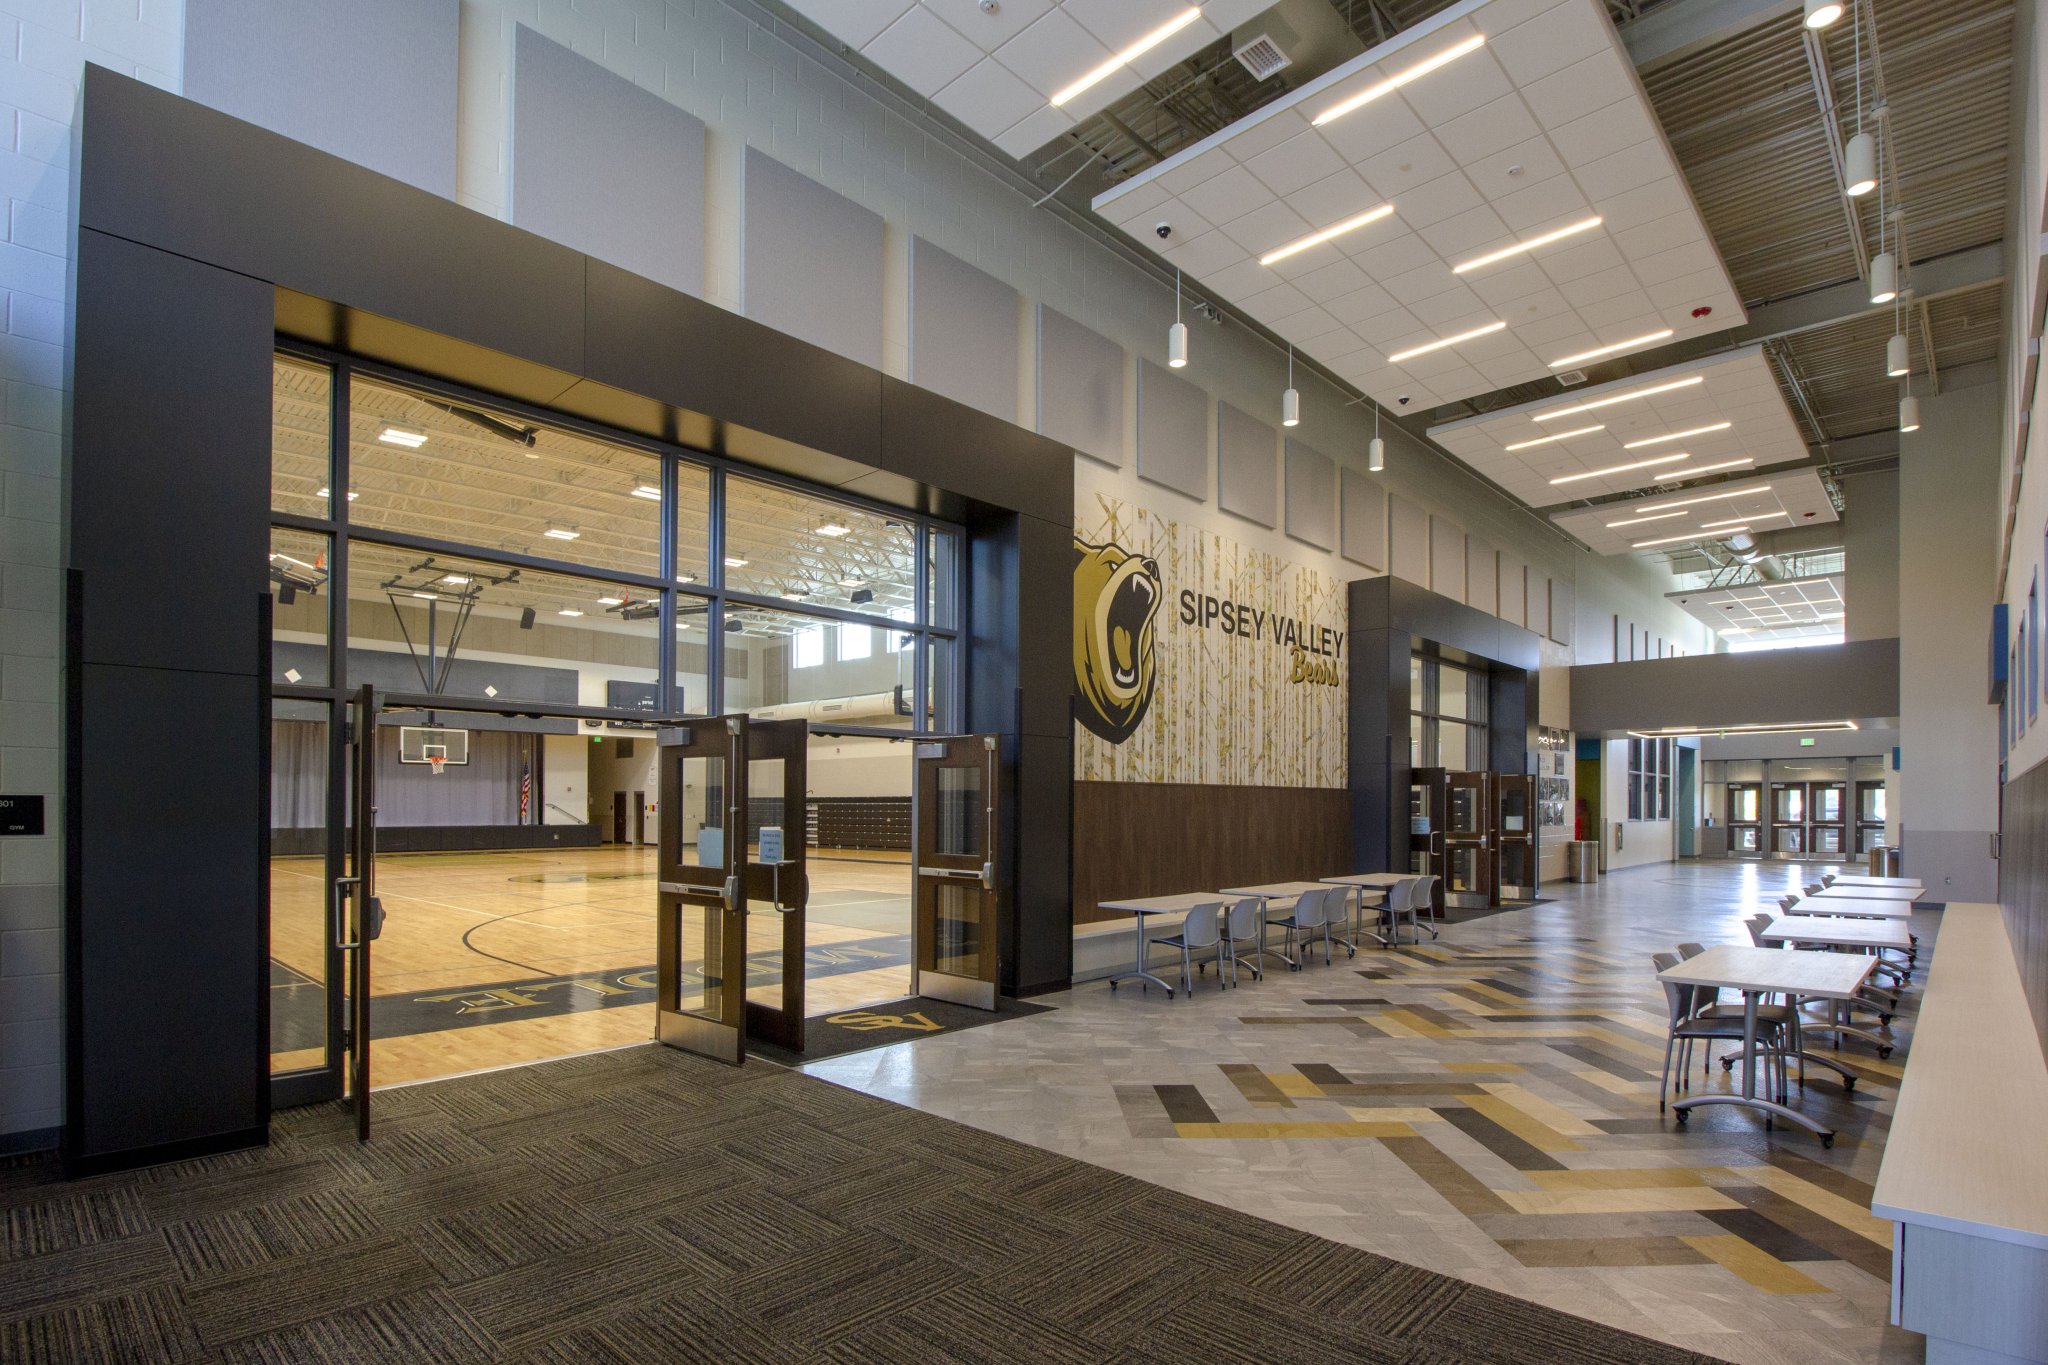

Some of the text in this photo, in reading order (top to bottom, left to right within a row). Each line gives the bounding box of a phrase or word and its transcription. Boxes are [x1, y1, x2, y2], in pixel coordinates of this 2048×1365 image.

[1180, 589, 1344, 659] SIPSEY VALLEY
[1290, 645, 1339, 687] Bears
